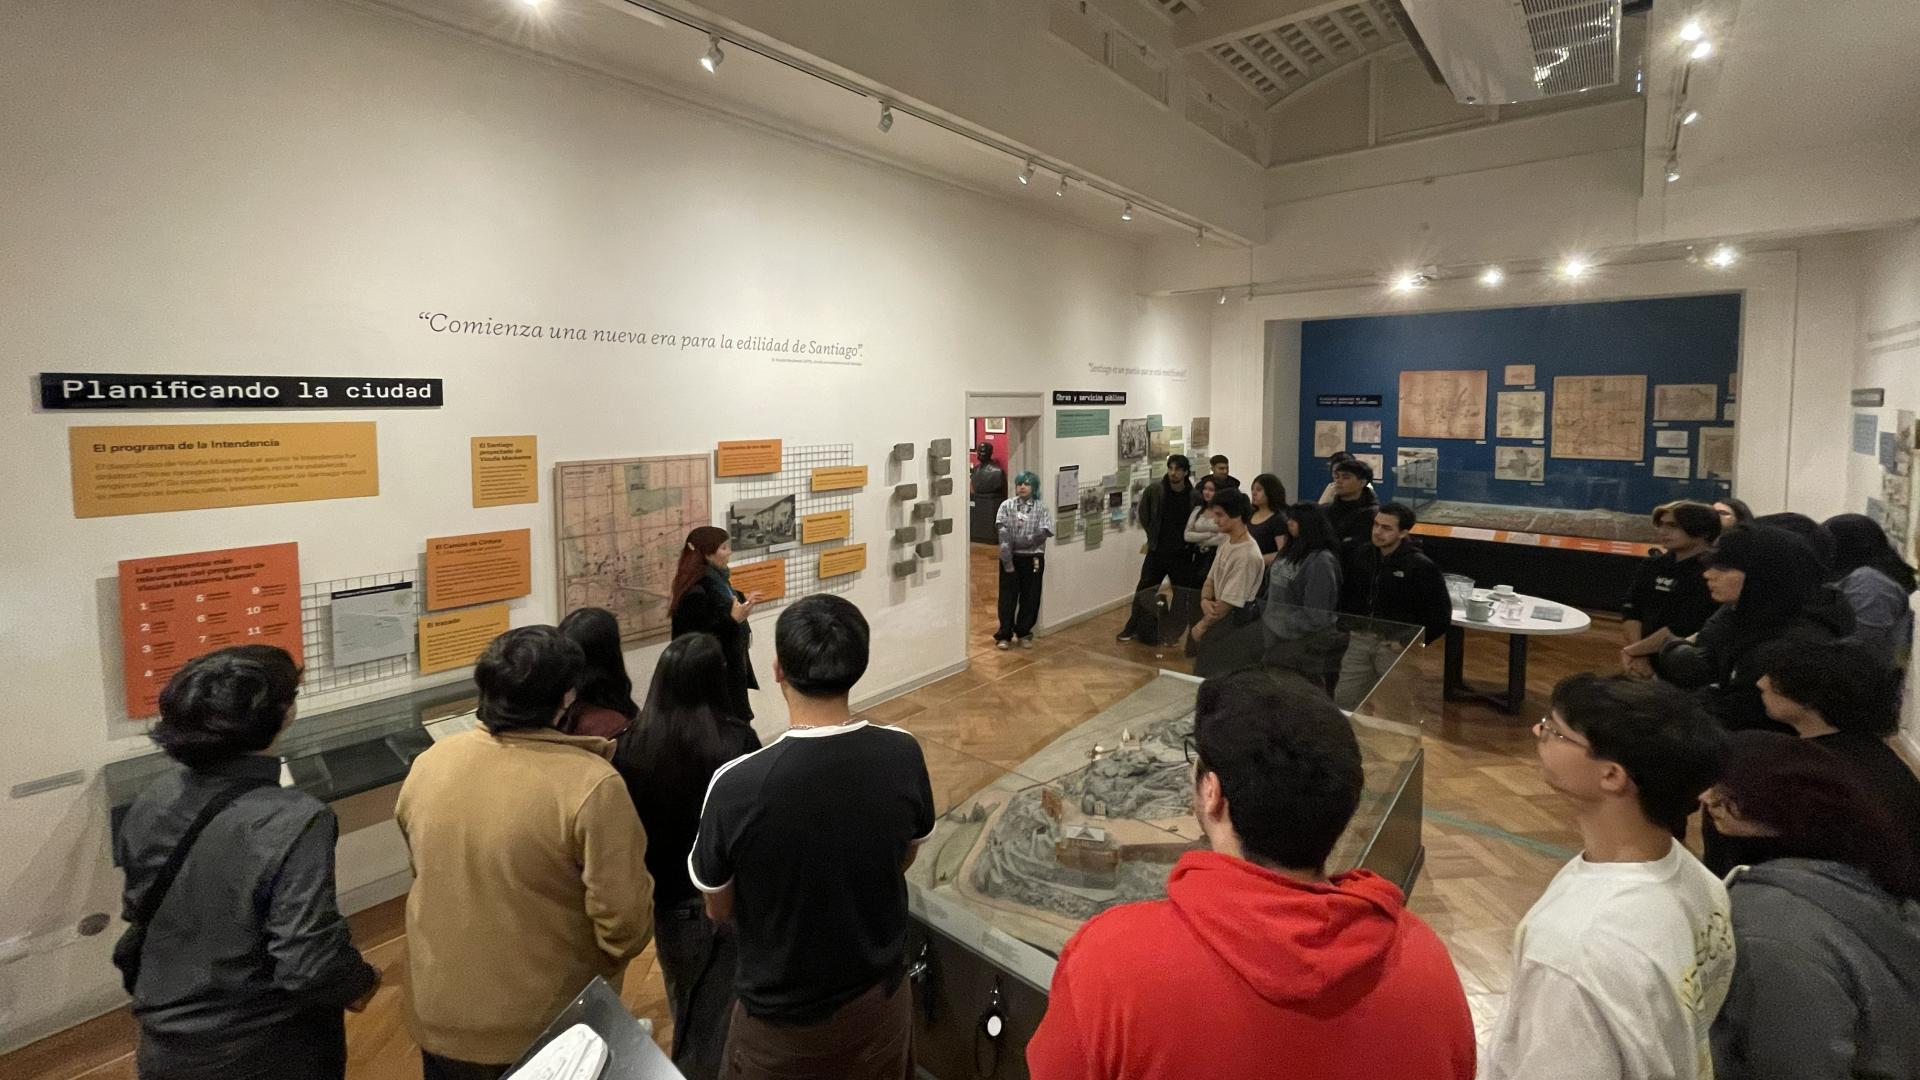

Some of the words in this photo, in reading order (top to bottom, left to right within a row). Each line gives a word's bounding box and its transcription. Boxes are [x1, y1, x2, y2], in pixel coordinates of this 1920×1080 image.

[550, 326, 588, 341] una
[593, 329, 646, 345] nueva
[651, 333, 677, 346] era
[681, 335, 716, 350] para
[720, 334, 733, 349] la
[737, 336, 789, 353] edilidad
[792, 340, 807, 354] de
[62, 380, 280, 400] Planificando
[298, 381, 328, 399] la
[346, 382, 432, 399] ciudad
[93, 443, 106, 453] El
[110, 443, 175, 454] programa
[178, 441, 195, 450] de
[197, 440, 208, 449] la
[211, 438, 280, 449] Intendencia
[135, 566, 154, 574] Las
[190, 569, 206, 577] del
[207, 564, 252, 576] programa
[195, 594, 204, 602] 5
[140, 602, 148, 611] 1
[246, 606, 261, 615] 10
[196, 615, 206, 623] 6
[140, 623, 150, 632] 2
[248, 626, 261, 635] 11
[142, 645, 151, 653] 3
